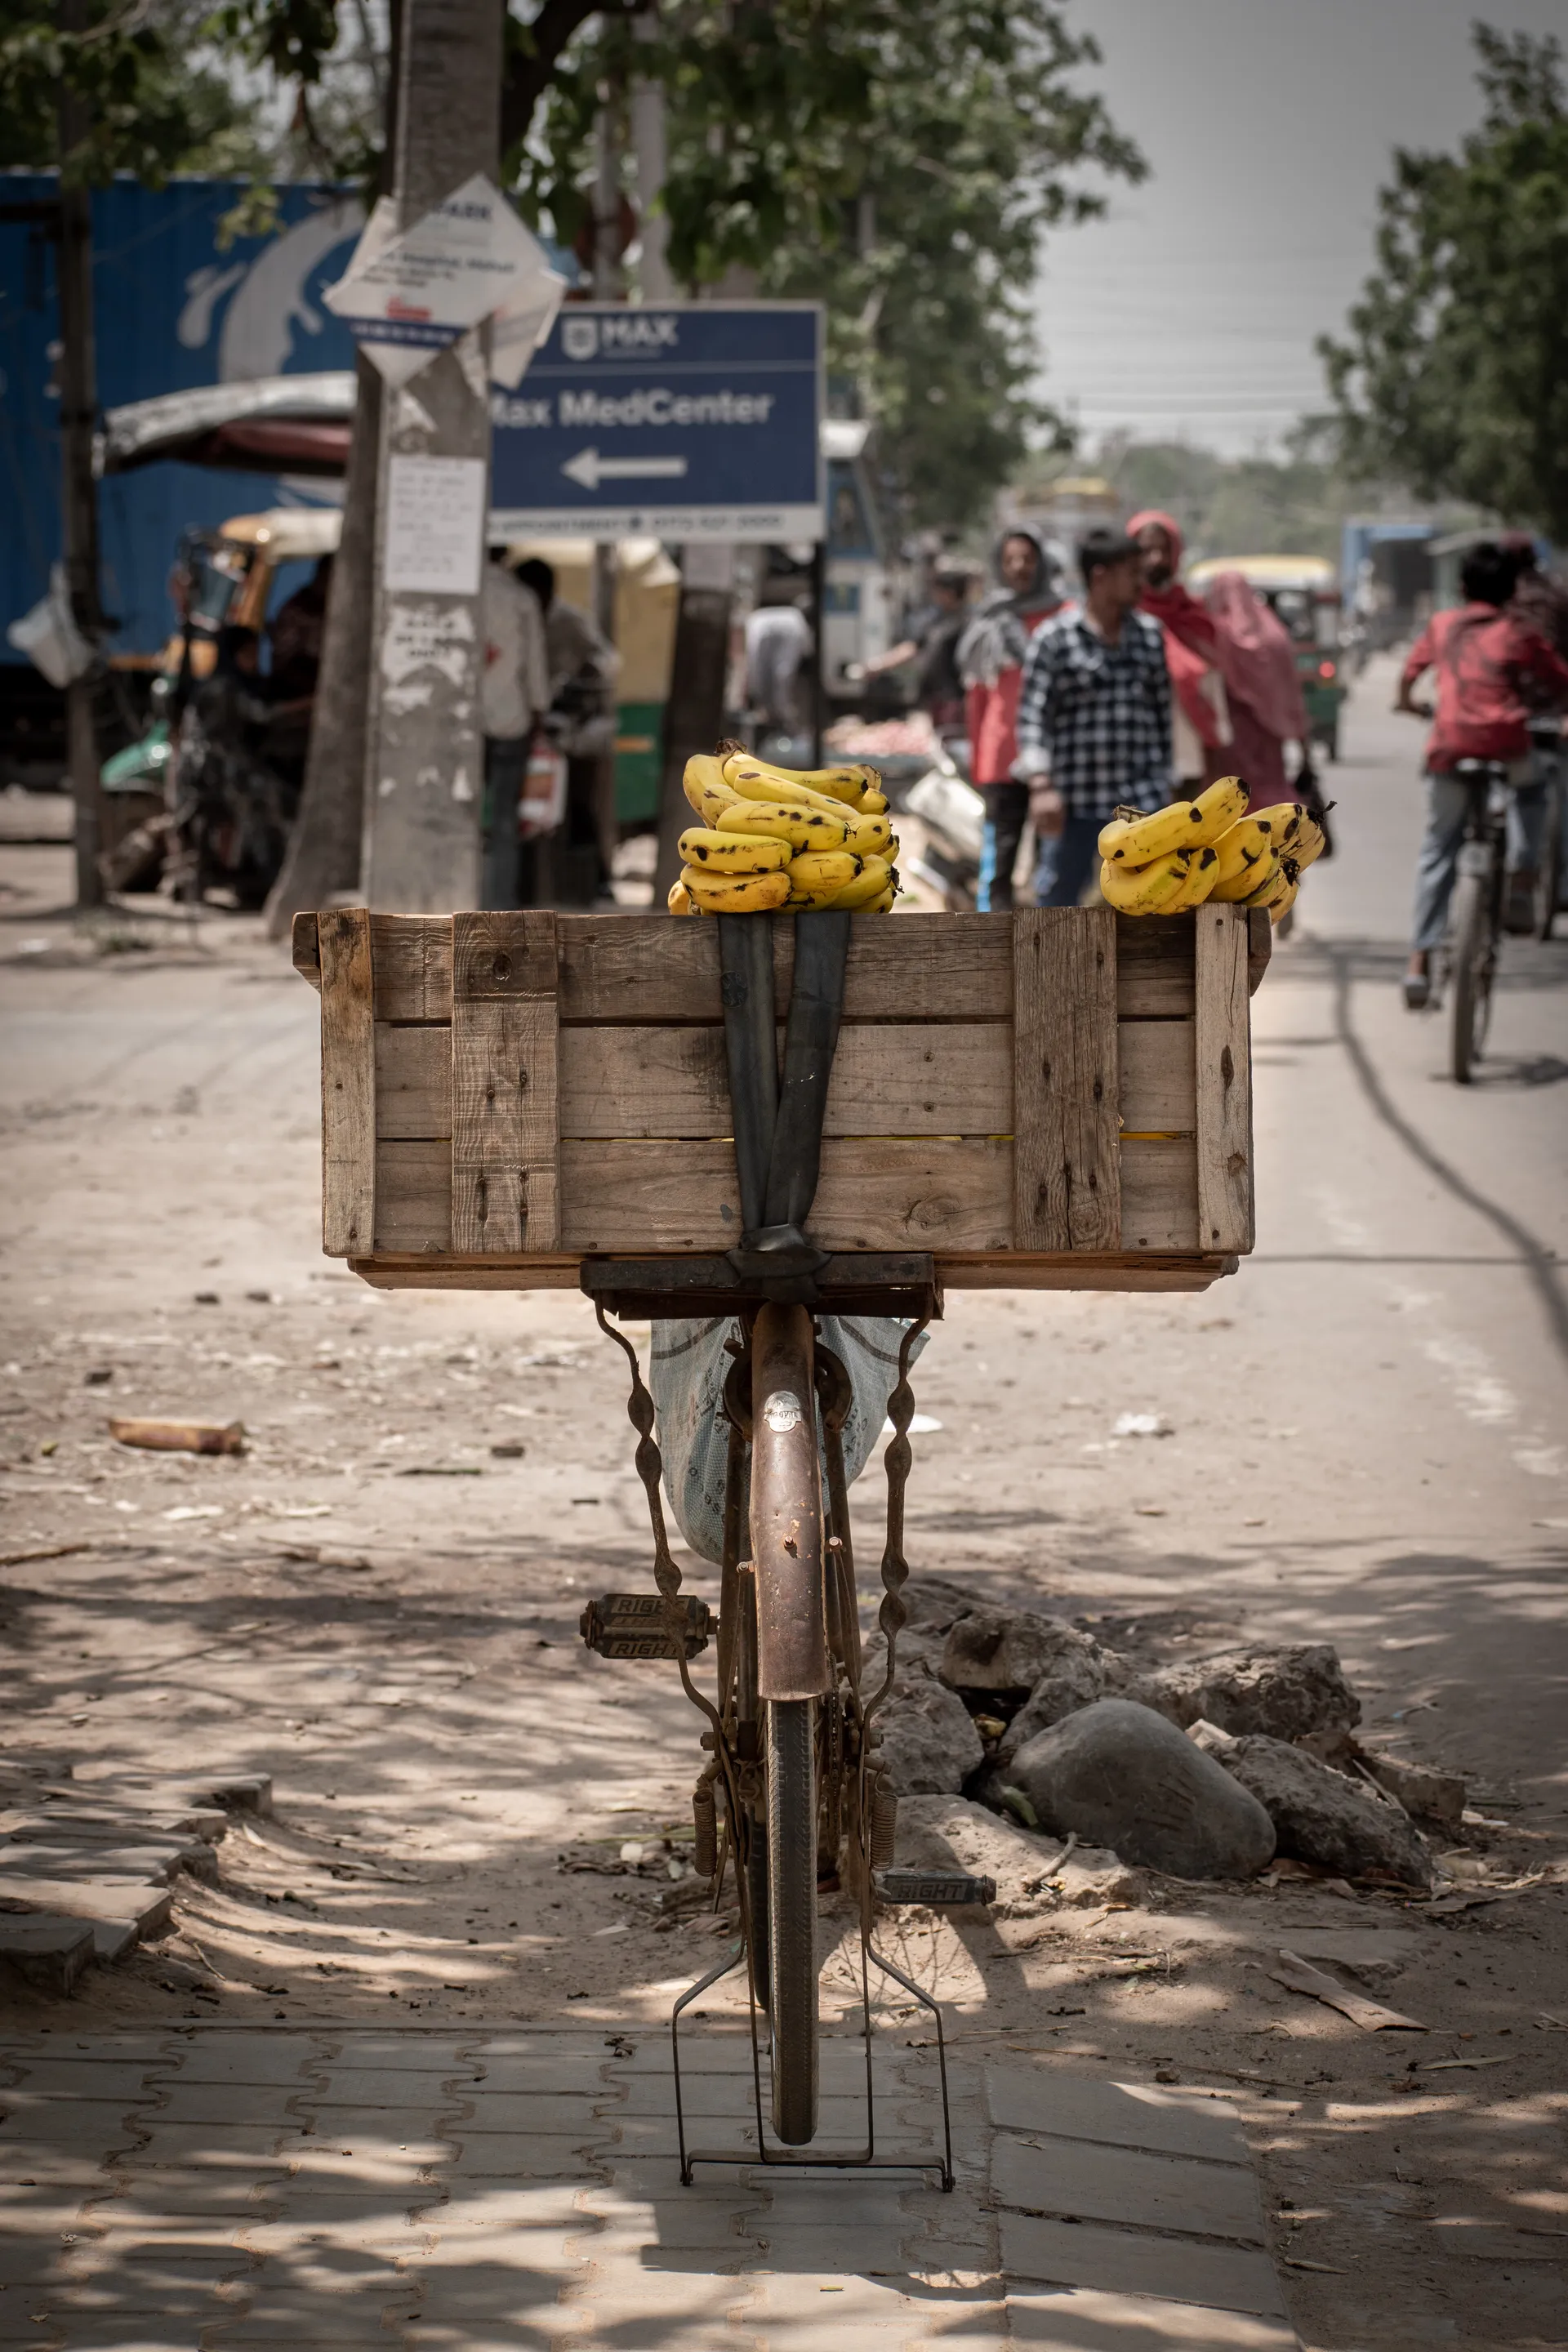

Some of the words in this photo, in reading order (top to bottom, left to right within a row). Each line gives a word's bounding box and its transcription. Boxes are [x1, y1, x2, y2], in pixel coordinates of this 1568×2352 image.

[601, 316, 679, 345] MAX
[559, 388, 774, 427] MedCenter
[617, 1599, 684, 1615] RIGH
[899, 1883, 963, 1899] RIGHT
